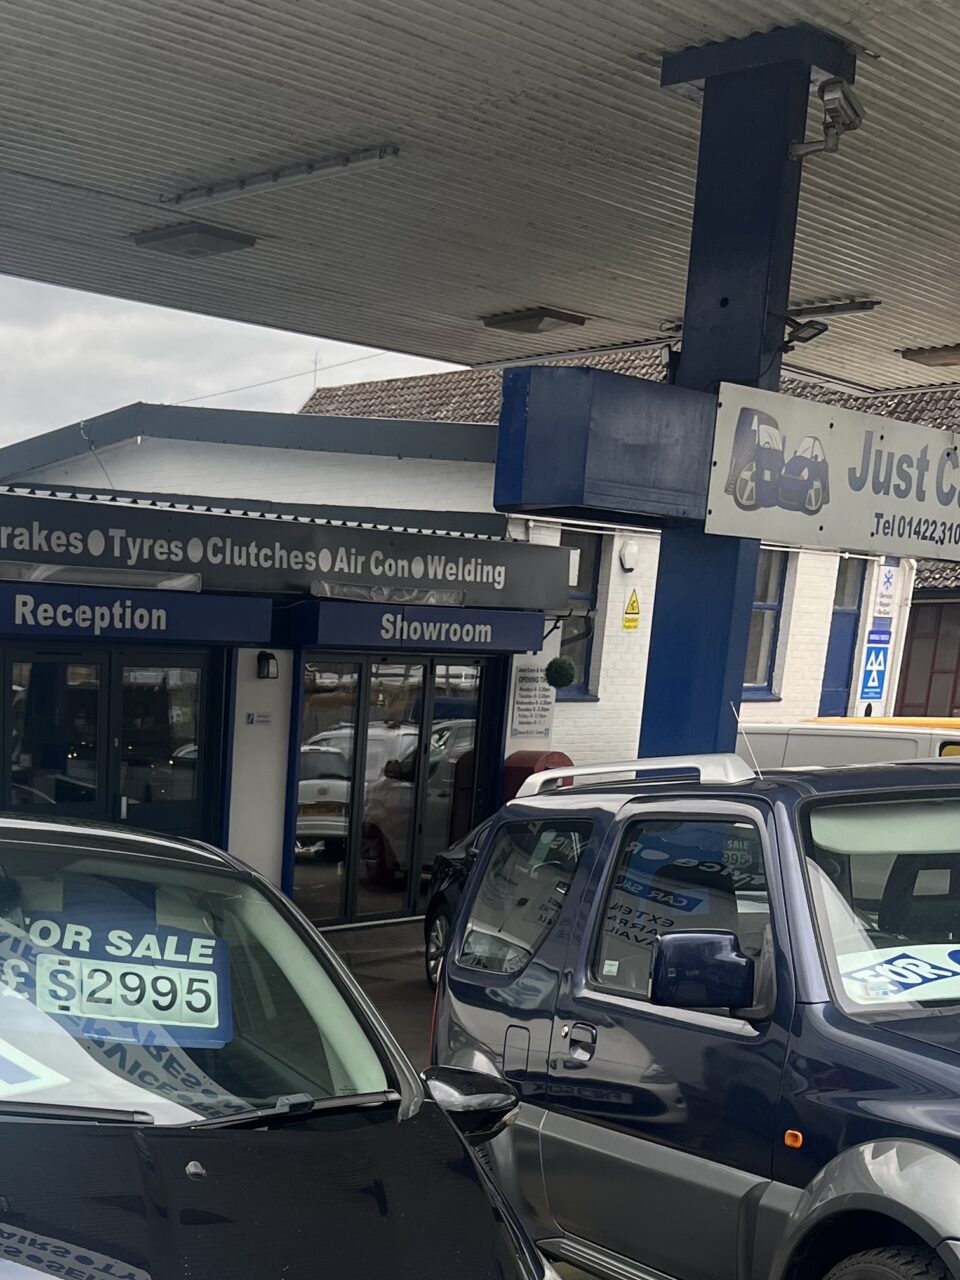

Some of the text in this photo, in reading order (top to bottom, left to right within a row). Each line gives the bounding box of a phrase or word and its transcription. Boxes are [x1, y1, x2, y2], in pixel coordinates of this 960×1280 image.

[848, 430, 960, 507] Just C
[875, 512, 896, 536] Tel
[108, 528, 183, 565] Tyres
[207, 536, 316, 571] Clutches
[334, 547, 366, 575] Air
[370, 550, 409, 578] Con
[427, 554, 506, 590] Welding
[15, 594, 167, 635] Reception
[381, 613, 492, 643] Showroom
[24, 917, 217, 964] OR SALE
[1, 959, 30, 999] £
[851, 958, 953, 991] FOR
